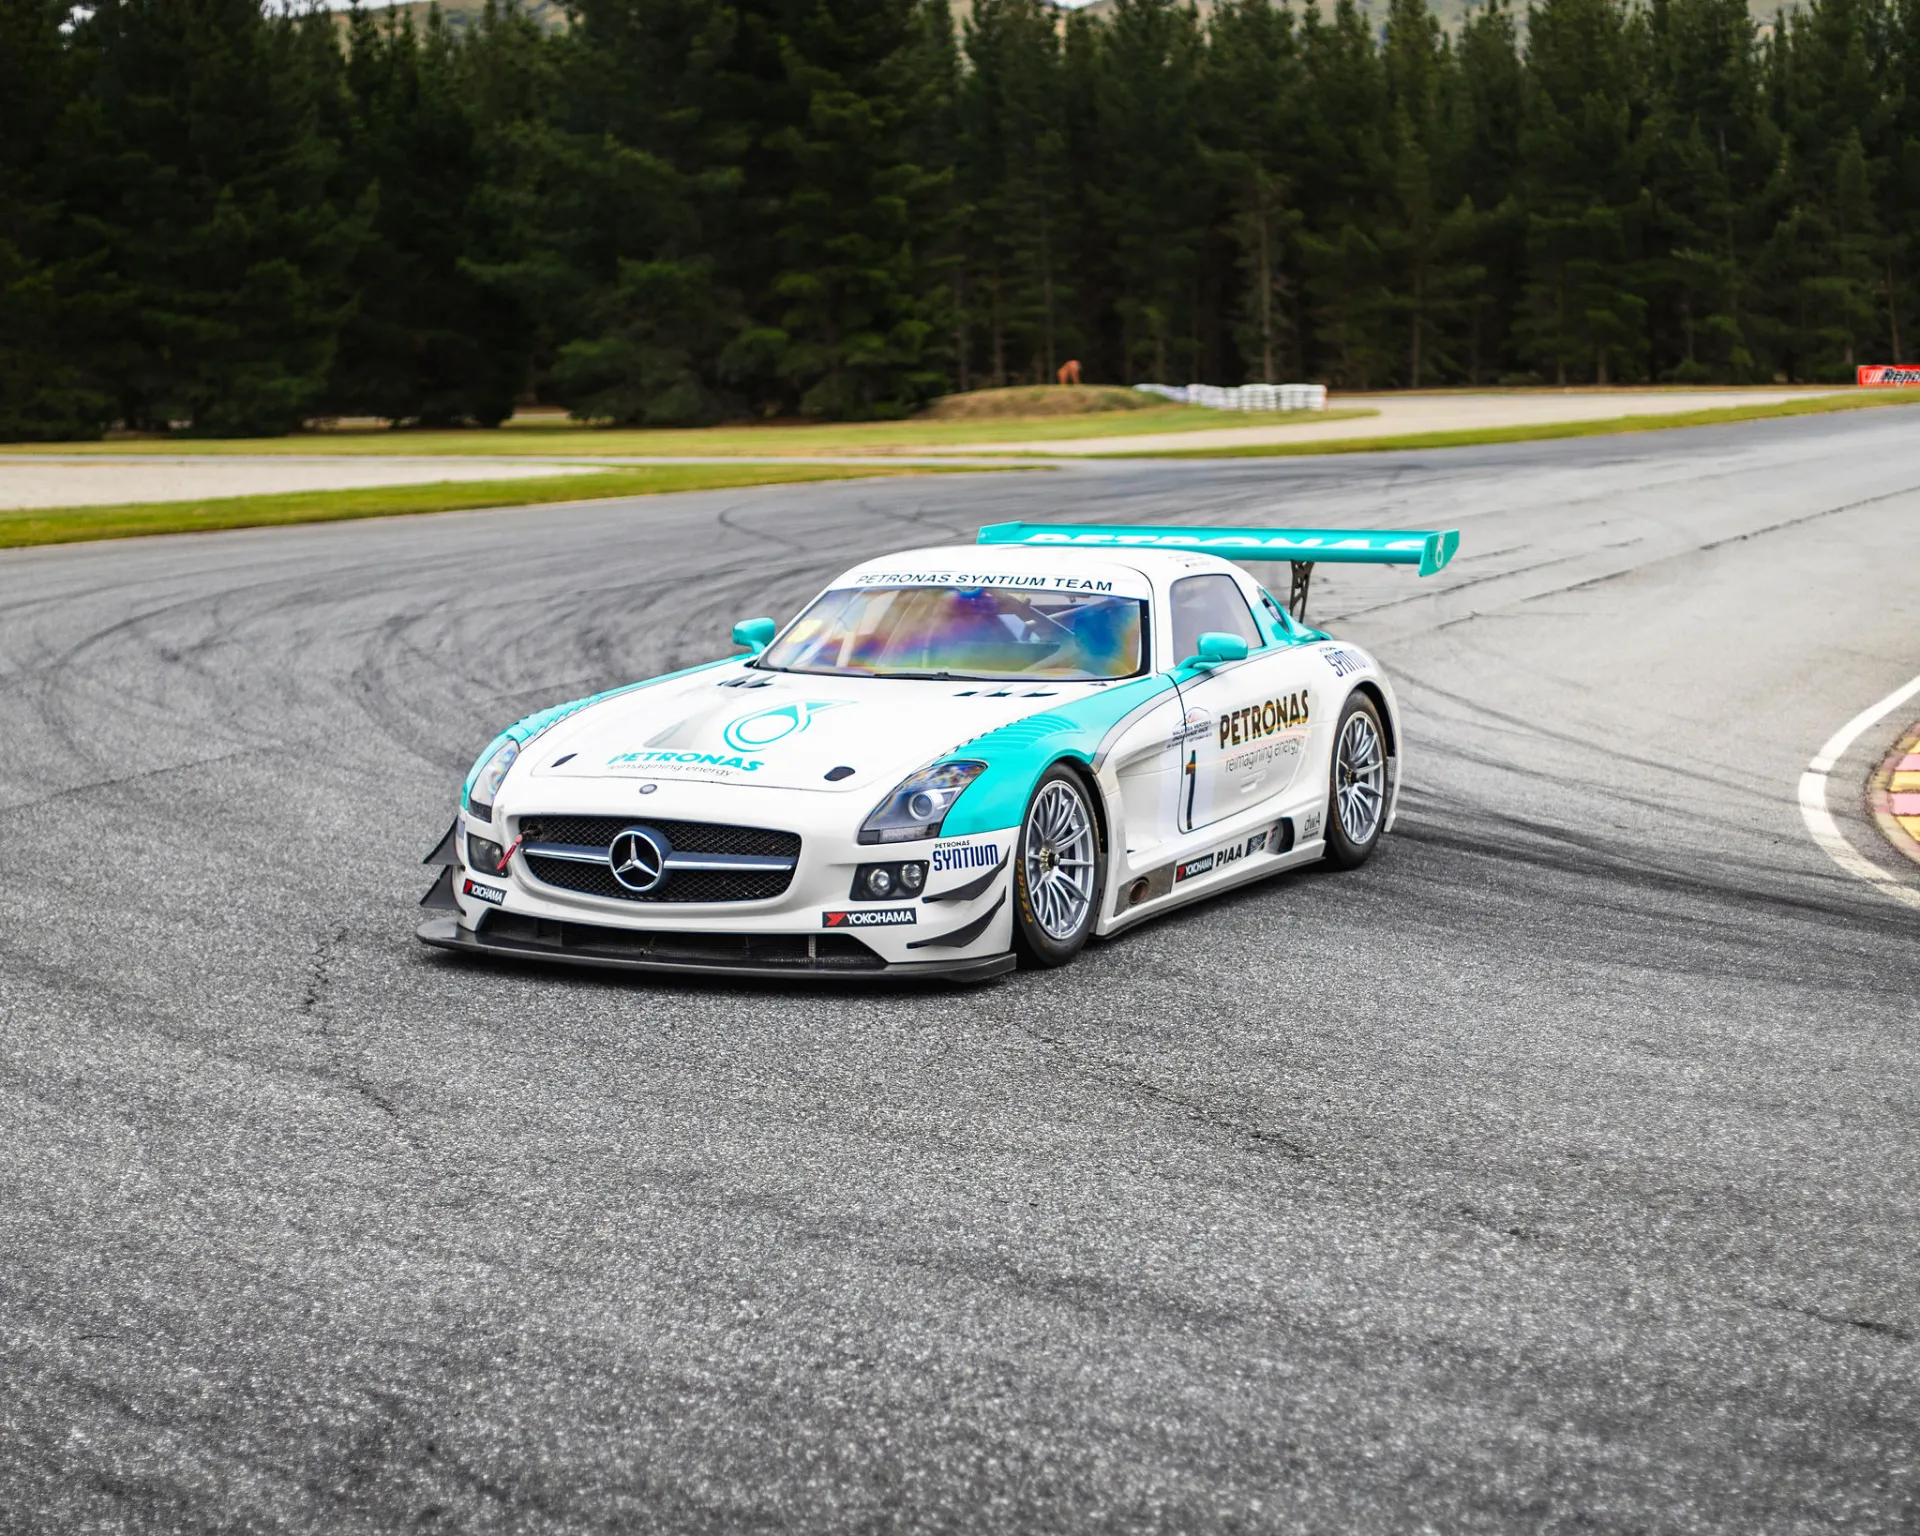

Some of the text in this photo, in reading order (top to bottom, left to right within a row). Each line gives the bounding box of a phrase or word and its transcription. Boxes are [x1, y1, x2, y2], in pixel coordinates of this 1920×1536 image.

[855, 573, 1113, 591] PETRONAS SYNTIUM TEAM
[1219, 689, 1309, 750] PETRONAS
[607, 752, 765, 771] PETRONAS
[1225, 736, 1302, 773] reimagining energy
[1185, 749, 1196, 830] 1
[934, 840, 970, 849] PETRONAS
[1215, 843, 1242, 867] PIAA
[932, 844, 999, 871] SYNTIUM
[847, 911, 914, 925] YOKOHAMA
